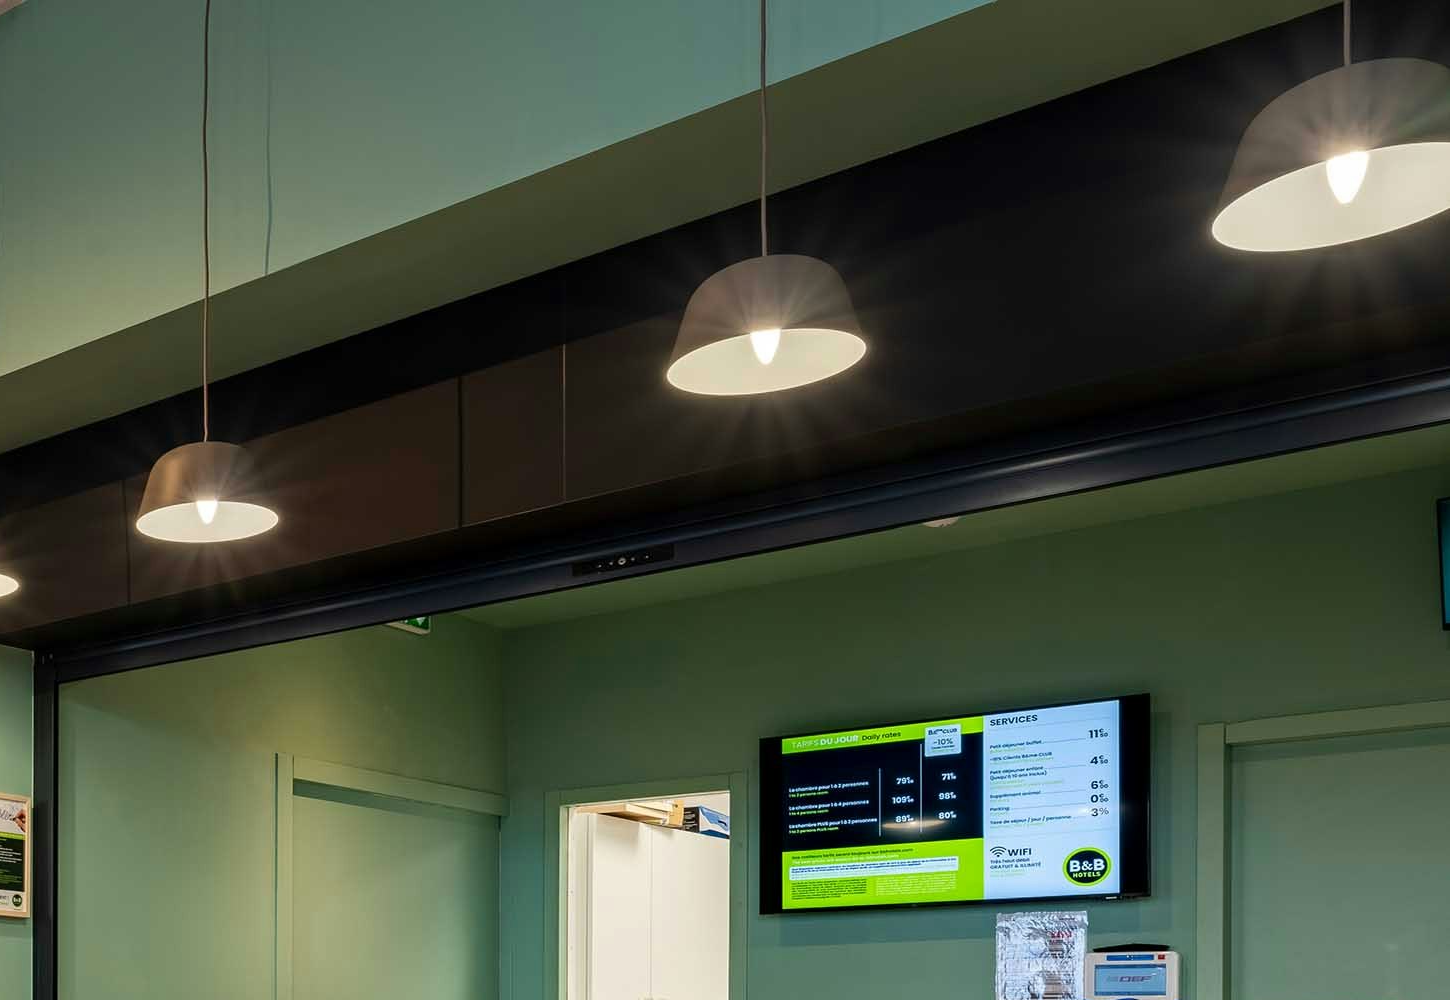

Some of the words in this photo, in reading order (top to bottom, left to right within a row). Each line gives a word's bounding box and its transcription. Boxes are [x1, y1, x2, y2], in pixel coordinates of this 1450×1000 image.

[990, 714, 1038, 726] SERVICES
[834, 735, 858, 744] JOUR
[1091, 808, 1109, 817] 3%
[1008, 848, 1032, 856] WIFI
[1070, 858, 1105, 872] B&B
